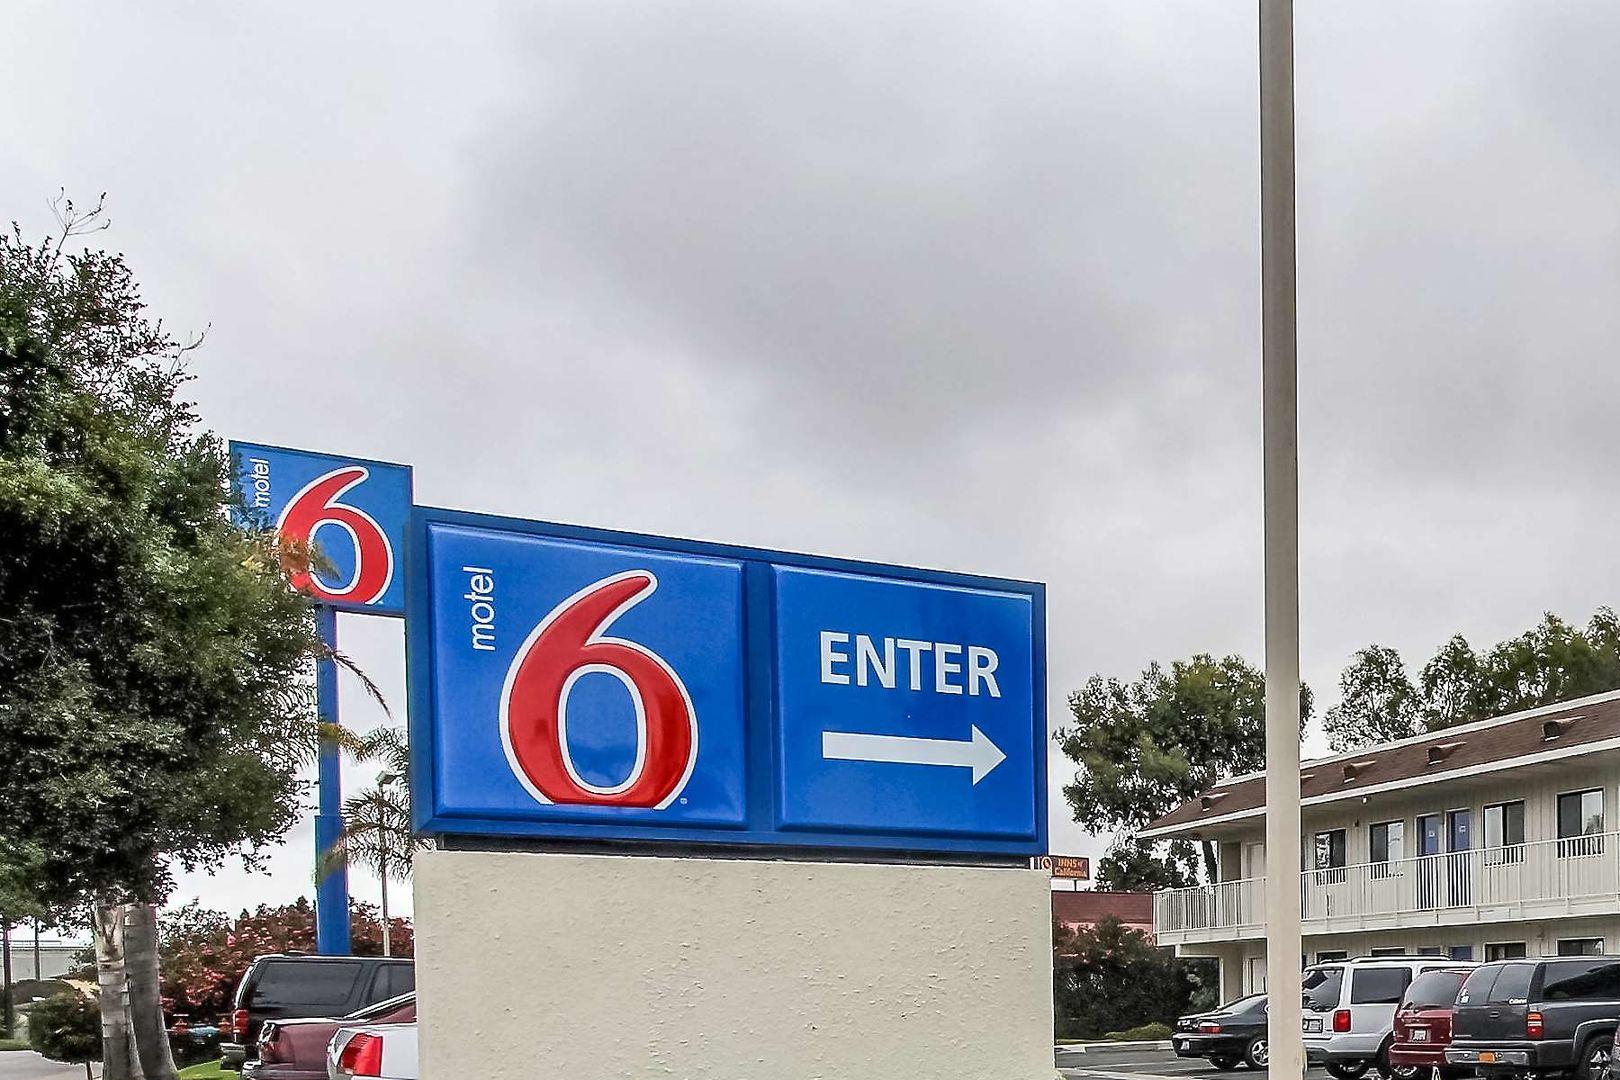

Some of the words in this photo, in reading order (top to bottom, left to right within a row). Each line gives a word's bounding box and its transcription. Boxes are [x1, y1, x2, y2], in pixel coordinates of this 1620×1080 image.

[250, 458, 271, 508] motel
[272, 465, 394, 605] 6
[462, 566, 496, 651] motel
[498, 569, 699, 811] 6
[820, 630, 1001, 698] ENTER
